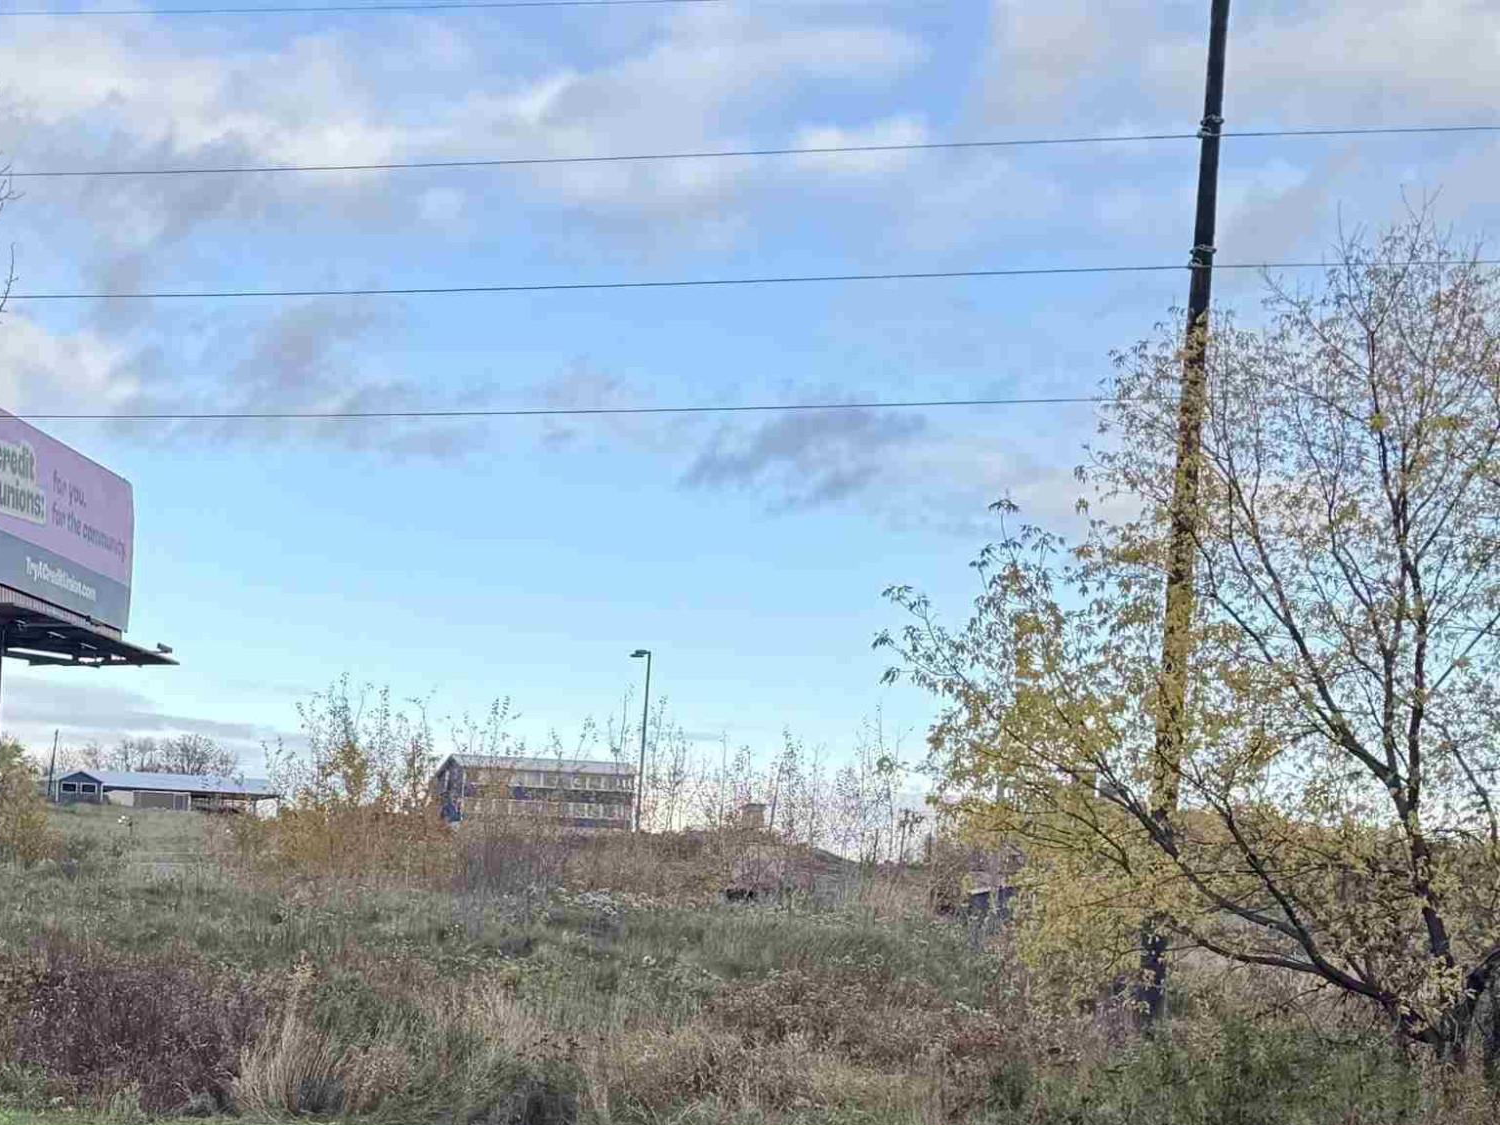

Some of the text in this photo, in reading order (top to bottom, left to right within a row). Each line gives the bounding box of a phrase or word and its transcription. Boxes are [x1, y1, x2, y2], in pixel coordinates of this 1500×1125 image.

[52, 468, 67, 497] for
[51, 501, 66, 531] for
[67, 511, 81, 536] the
